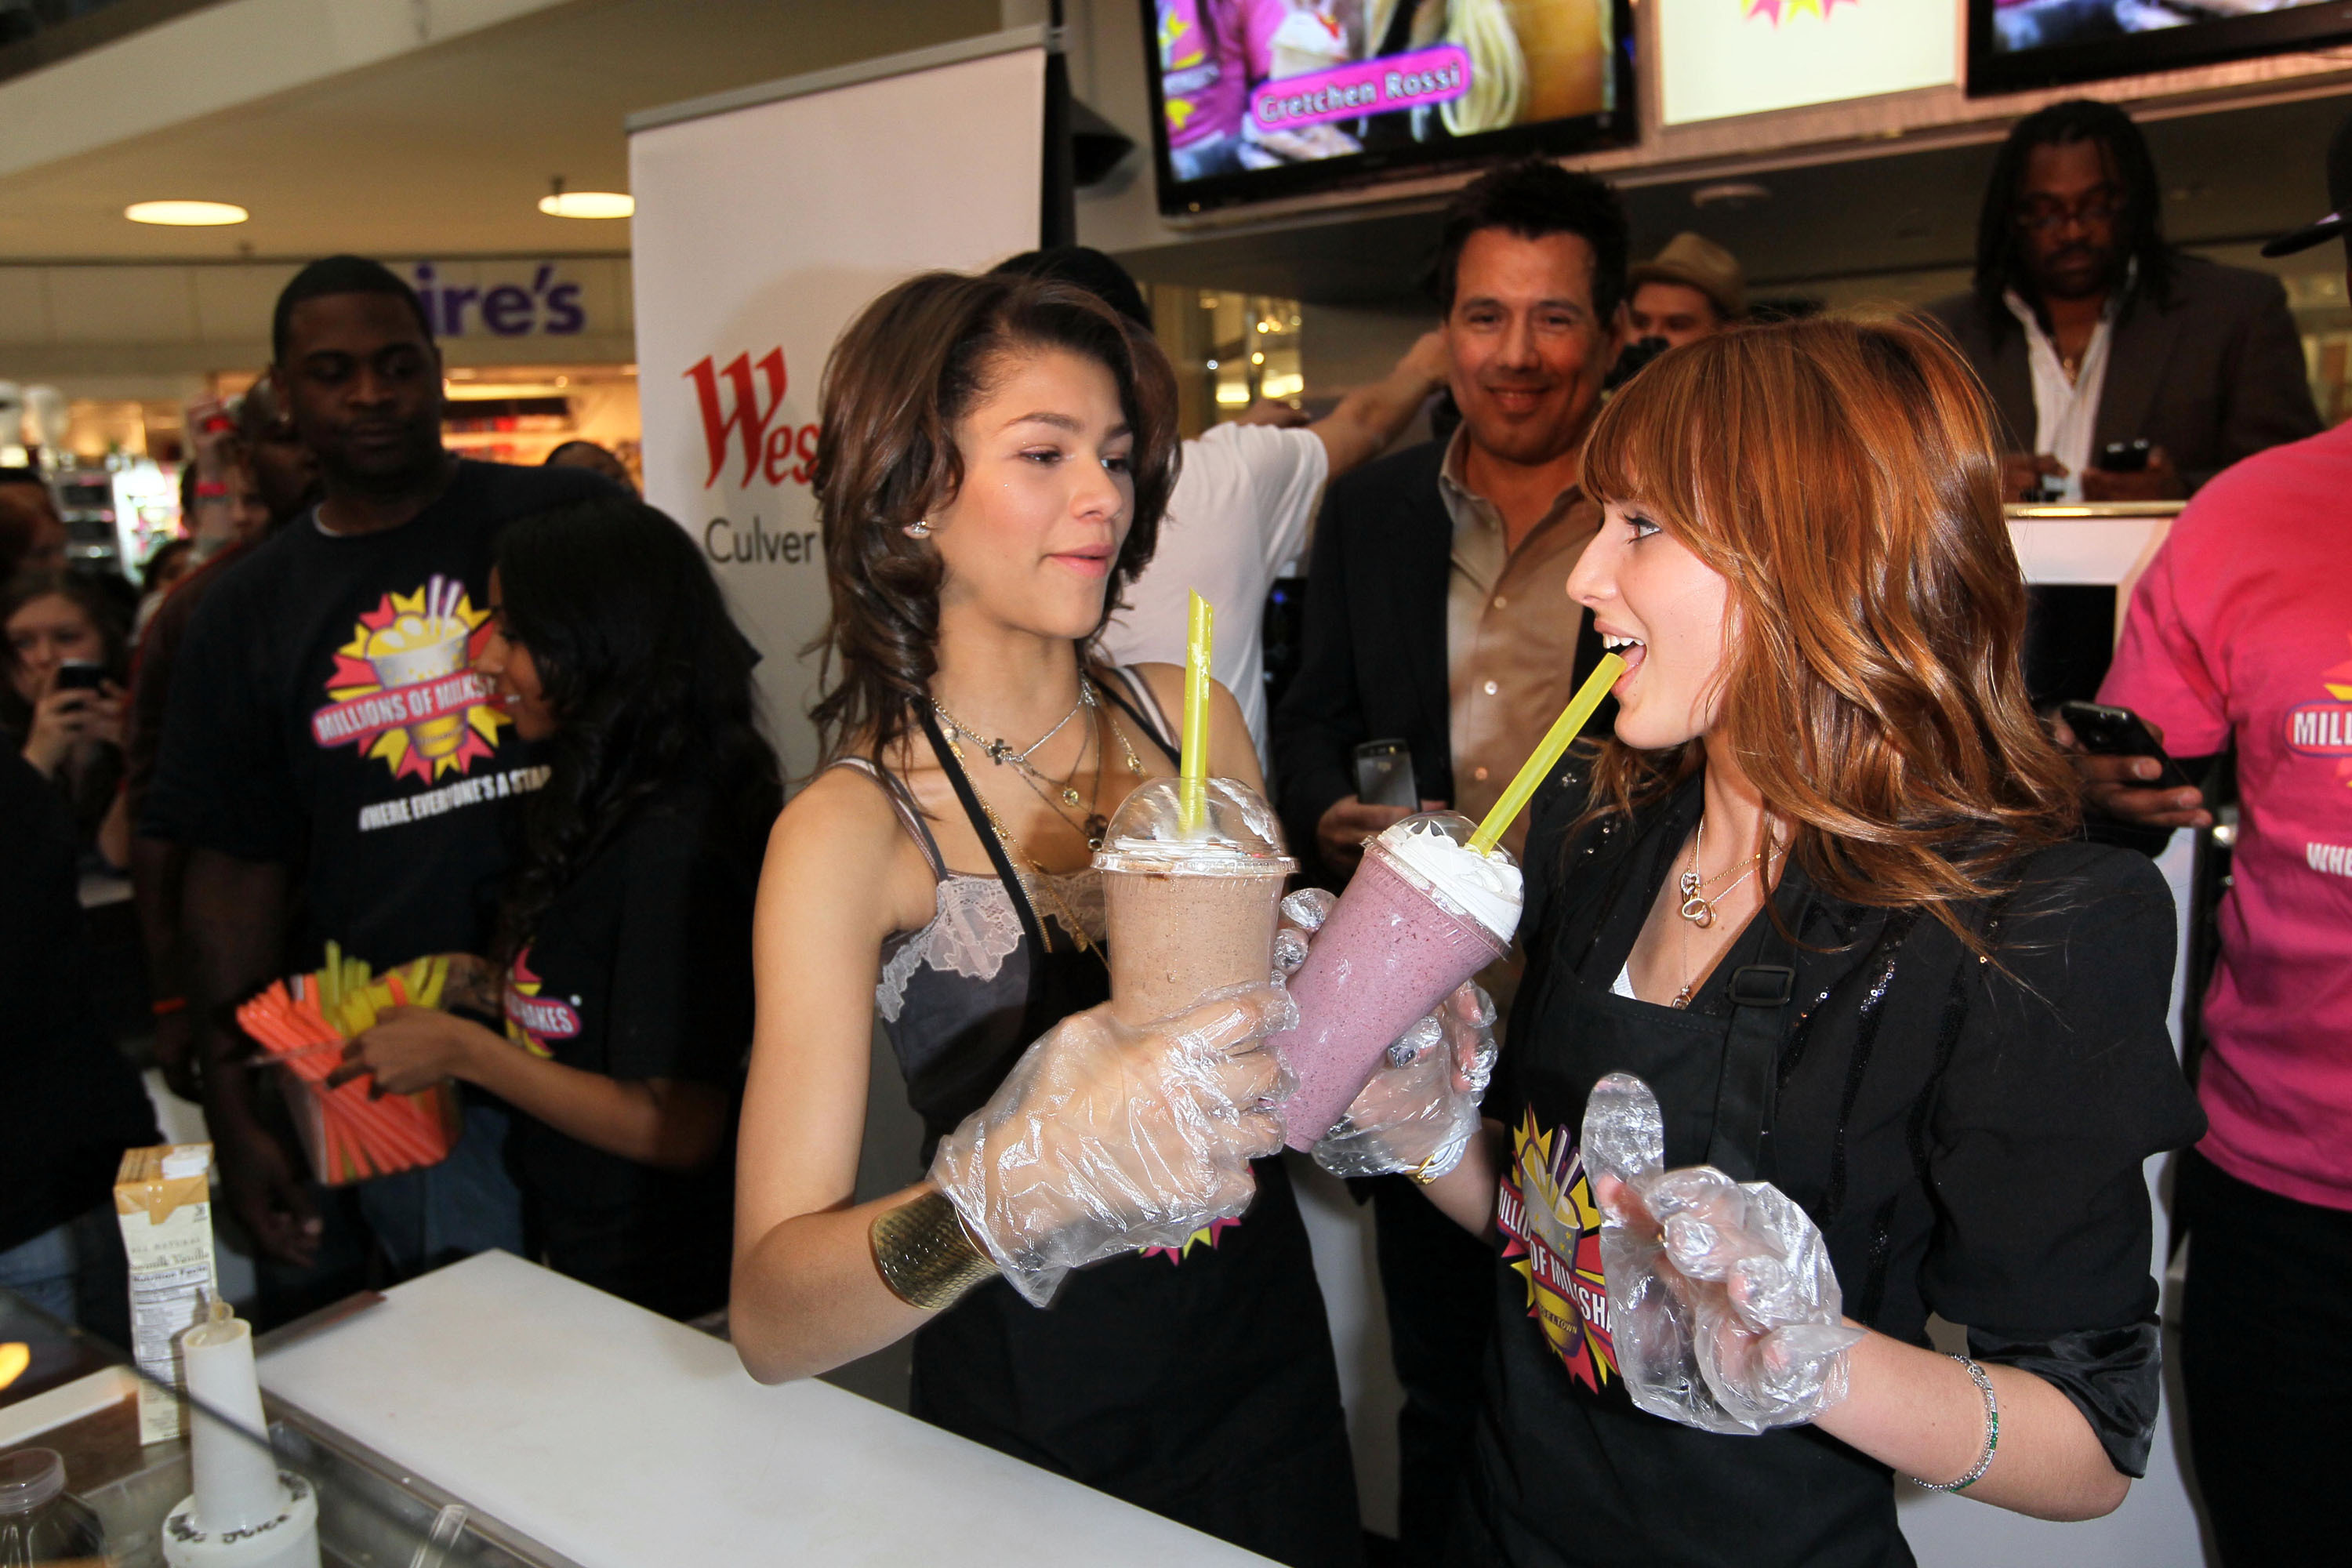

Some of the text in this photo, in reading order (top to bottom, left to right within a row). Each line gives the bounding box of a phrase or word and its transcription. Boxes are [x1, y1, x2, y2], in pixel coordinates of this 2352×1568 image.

[1258, 63, 1460, 124] Gretchen Rossi
[416, 264, 586, 336] ire's
[681, 345, 820, 490] Wes
[706, 515, 816, 564] Culver
[316, 693, 408, 741] MILLIONS
[408, 687, 433, 717] OF
[2293, 711, 2352, 746] MILL
[358, 798, 412, 832] WHERE
[409, 775, 496, 820] EVERYONE'S
[495, 771, 510, 798] A
[131, 1272, 178, 1283] Nutrition
[1530, 1239, 1547, 1276] OF
